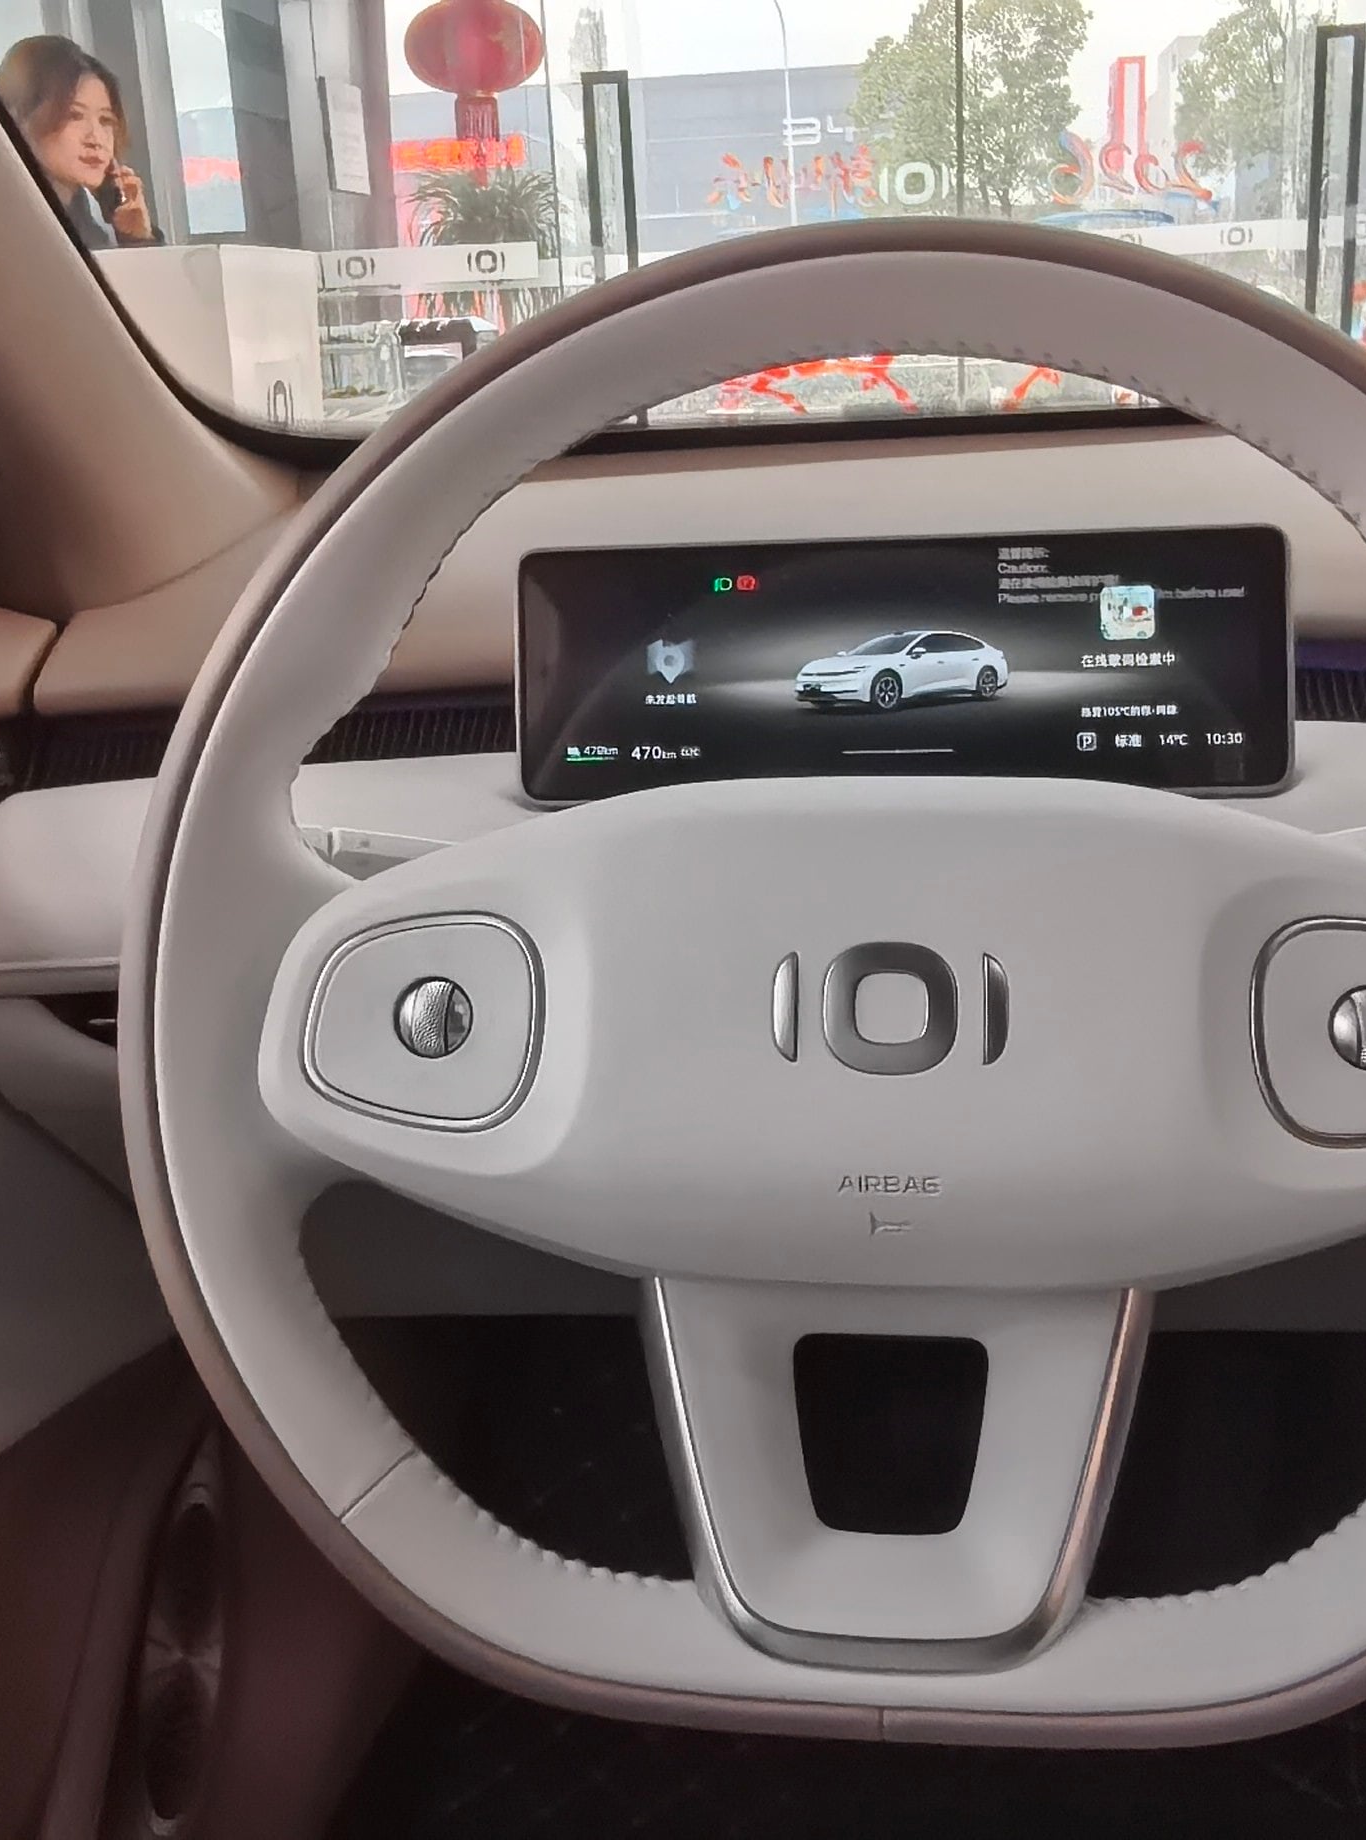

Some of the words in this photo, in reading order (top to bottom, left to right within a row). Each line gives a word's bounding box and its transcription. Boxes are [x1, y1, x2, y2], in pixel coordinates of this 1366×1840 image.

[1115, 733, 1142, 748] 标准
[1206, 732, 1244, 745] 10:30
[837, 1174, 943, 1196] AIRBAG
